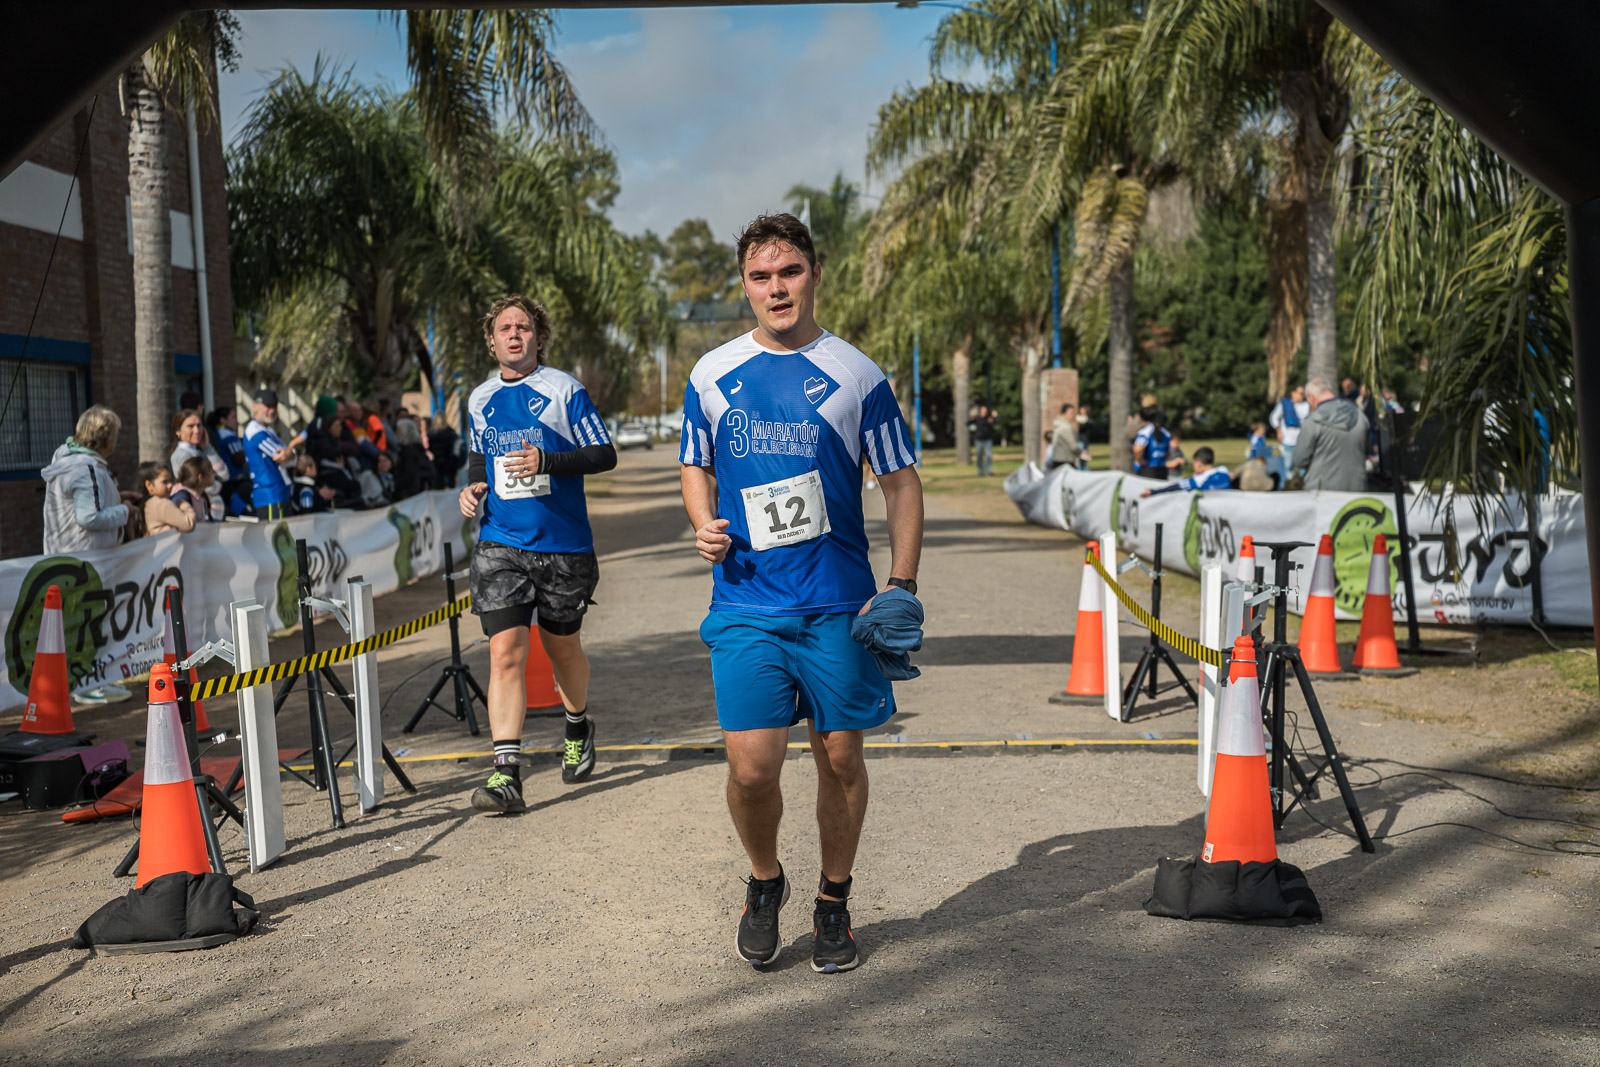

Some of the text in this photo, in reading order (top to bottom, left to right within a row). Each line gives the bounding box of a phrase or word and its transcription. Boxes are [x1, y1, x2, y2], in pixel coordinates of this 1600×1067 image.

[484, 426, 500, 457] 3
[726, 408, 750, 459] 3
[752, 420, 820, 443] MARATÓN
[763, 495, 812, 534] 12
